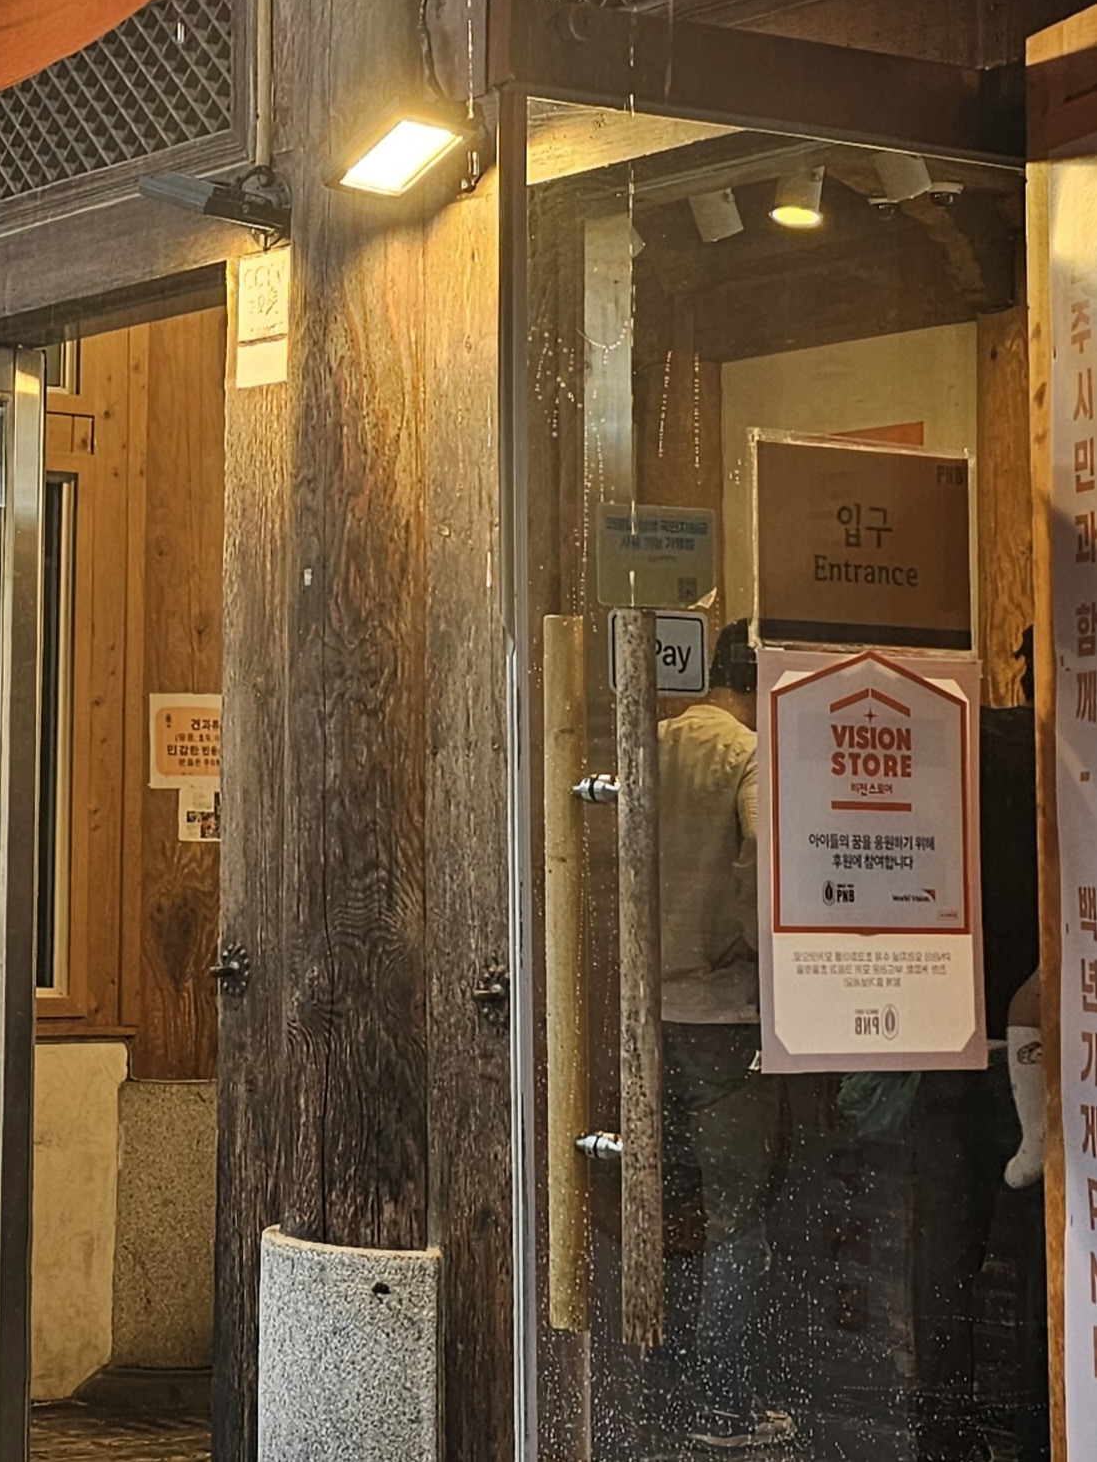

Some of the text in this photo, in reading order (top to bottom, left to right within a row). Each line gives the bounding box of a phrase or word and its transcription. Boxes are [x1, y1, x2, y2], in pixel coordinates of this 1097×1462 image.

[836, 502, 894, 550] 입구
[813, 553, 919, 587] Entrance
[829, 723, 913, 751] VISION
[830, 751, 913, 778] STORE
[863, 854, 915, 871] 참여합니다
[836, 889, 856, 903] PNB
